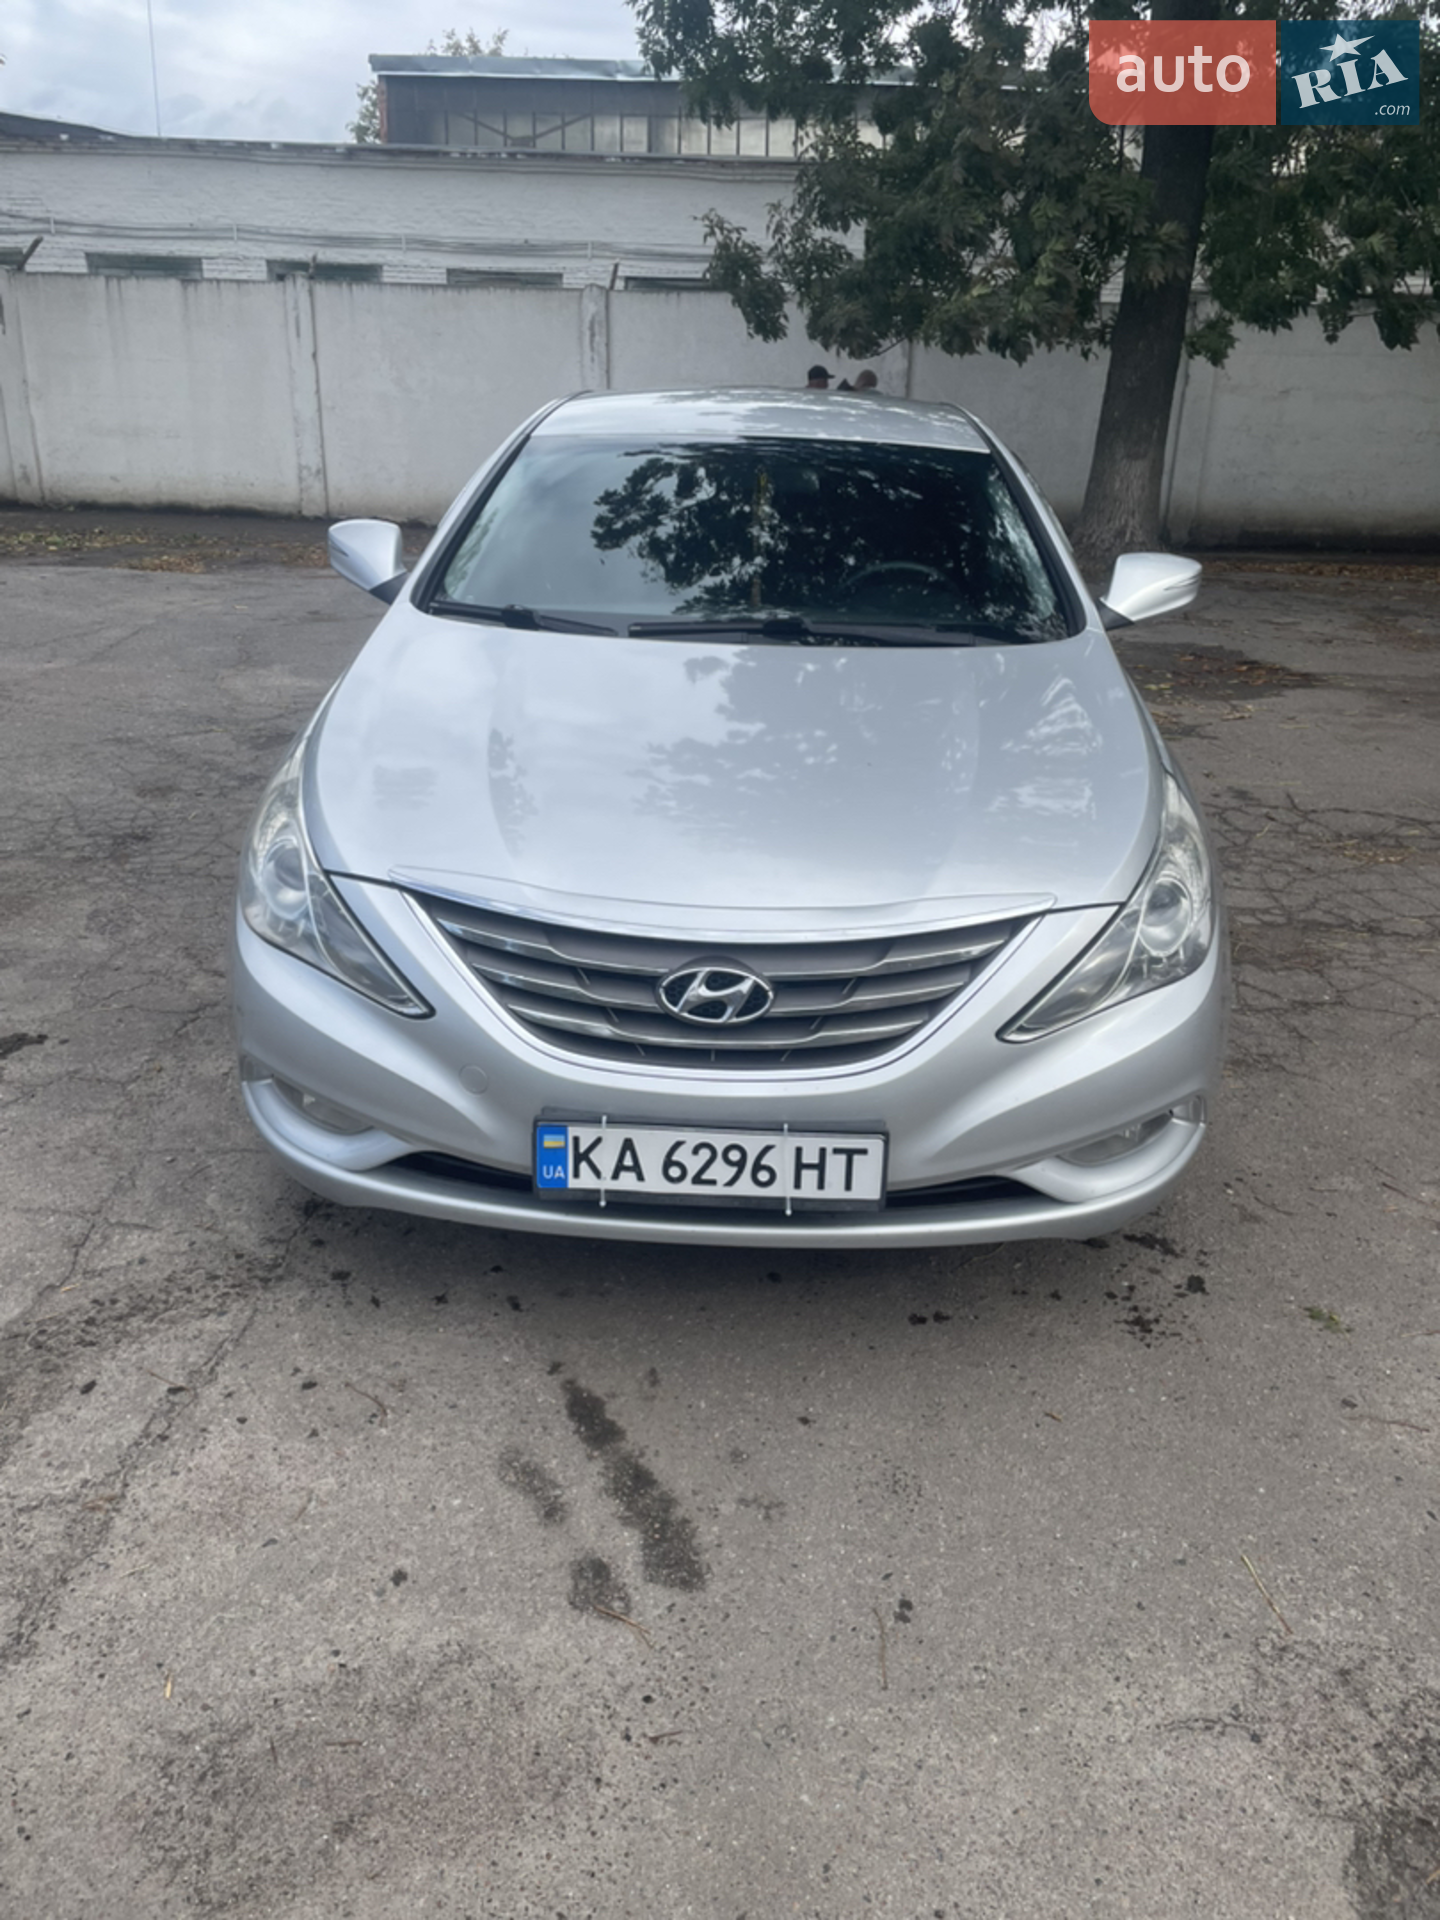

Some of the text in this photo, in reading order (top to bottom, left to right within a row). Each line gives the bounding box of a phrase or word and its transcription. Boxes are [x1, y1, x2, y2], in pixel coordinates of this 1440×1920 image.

[543, 1165, 565, 1180] UA
[572, 1136, 868, 1191] KA 6296 HT
